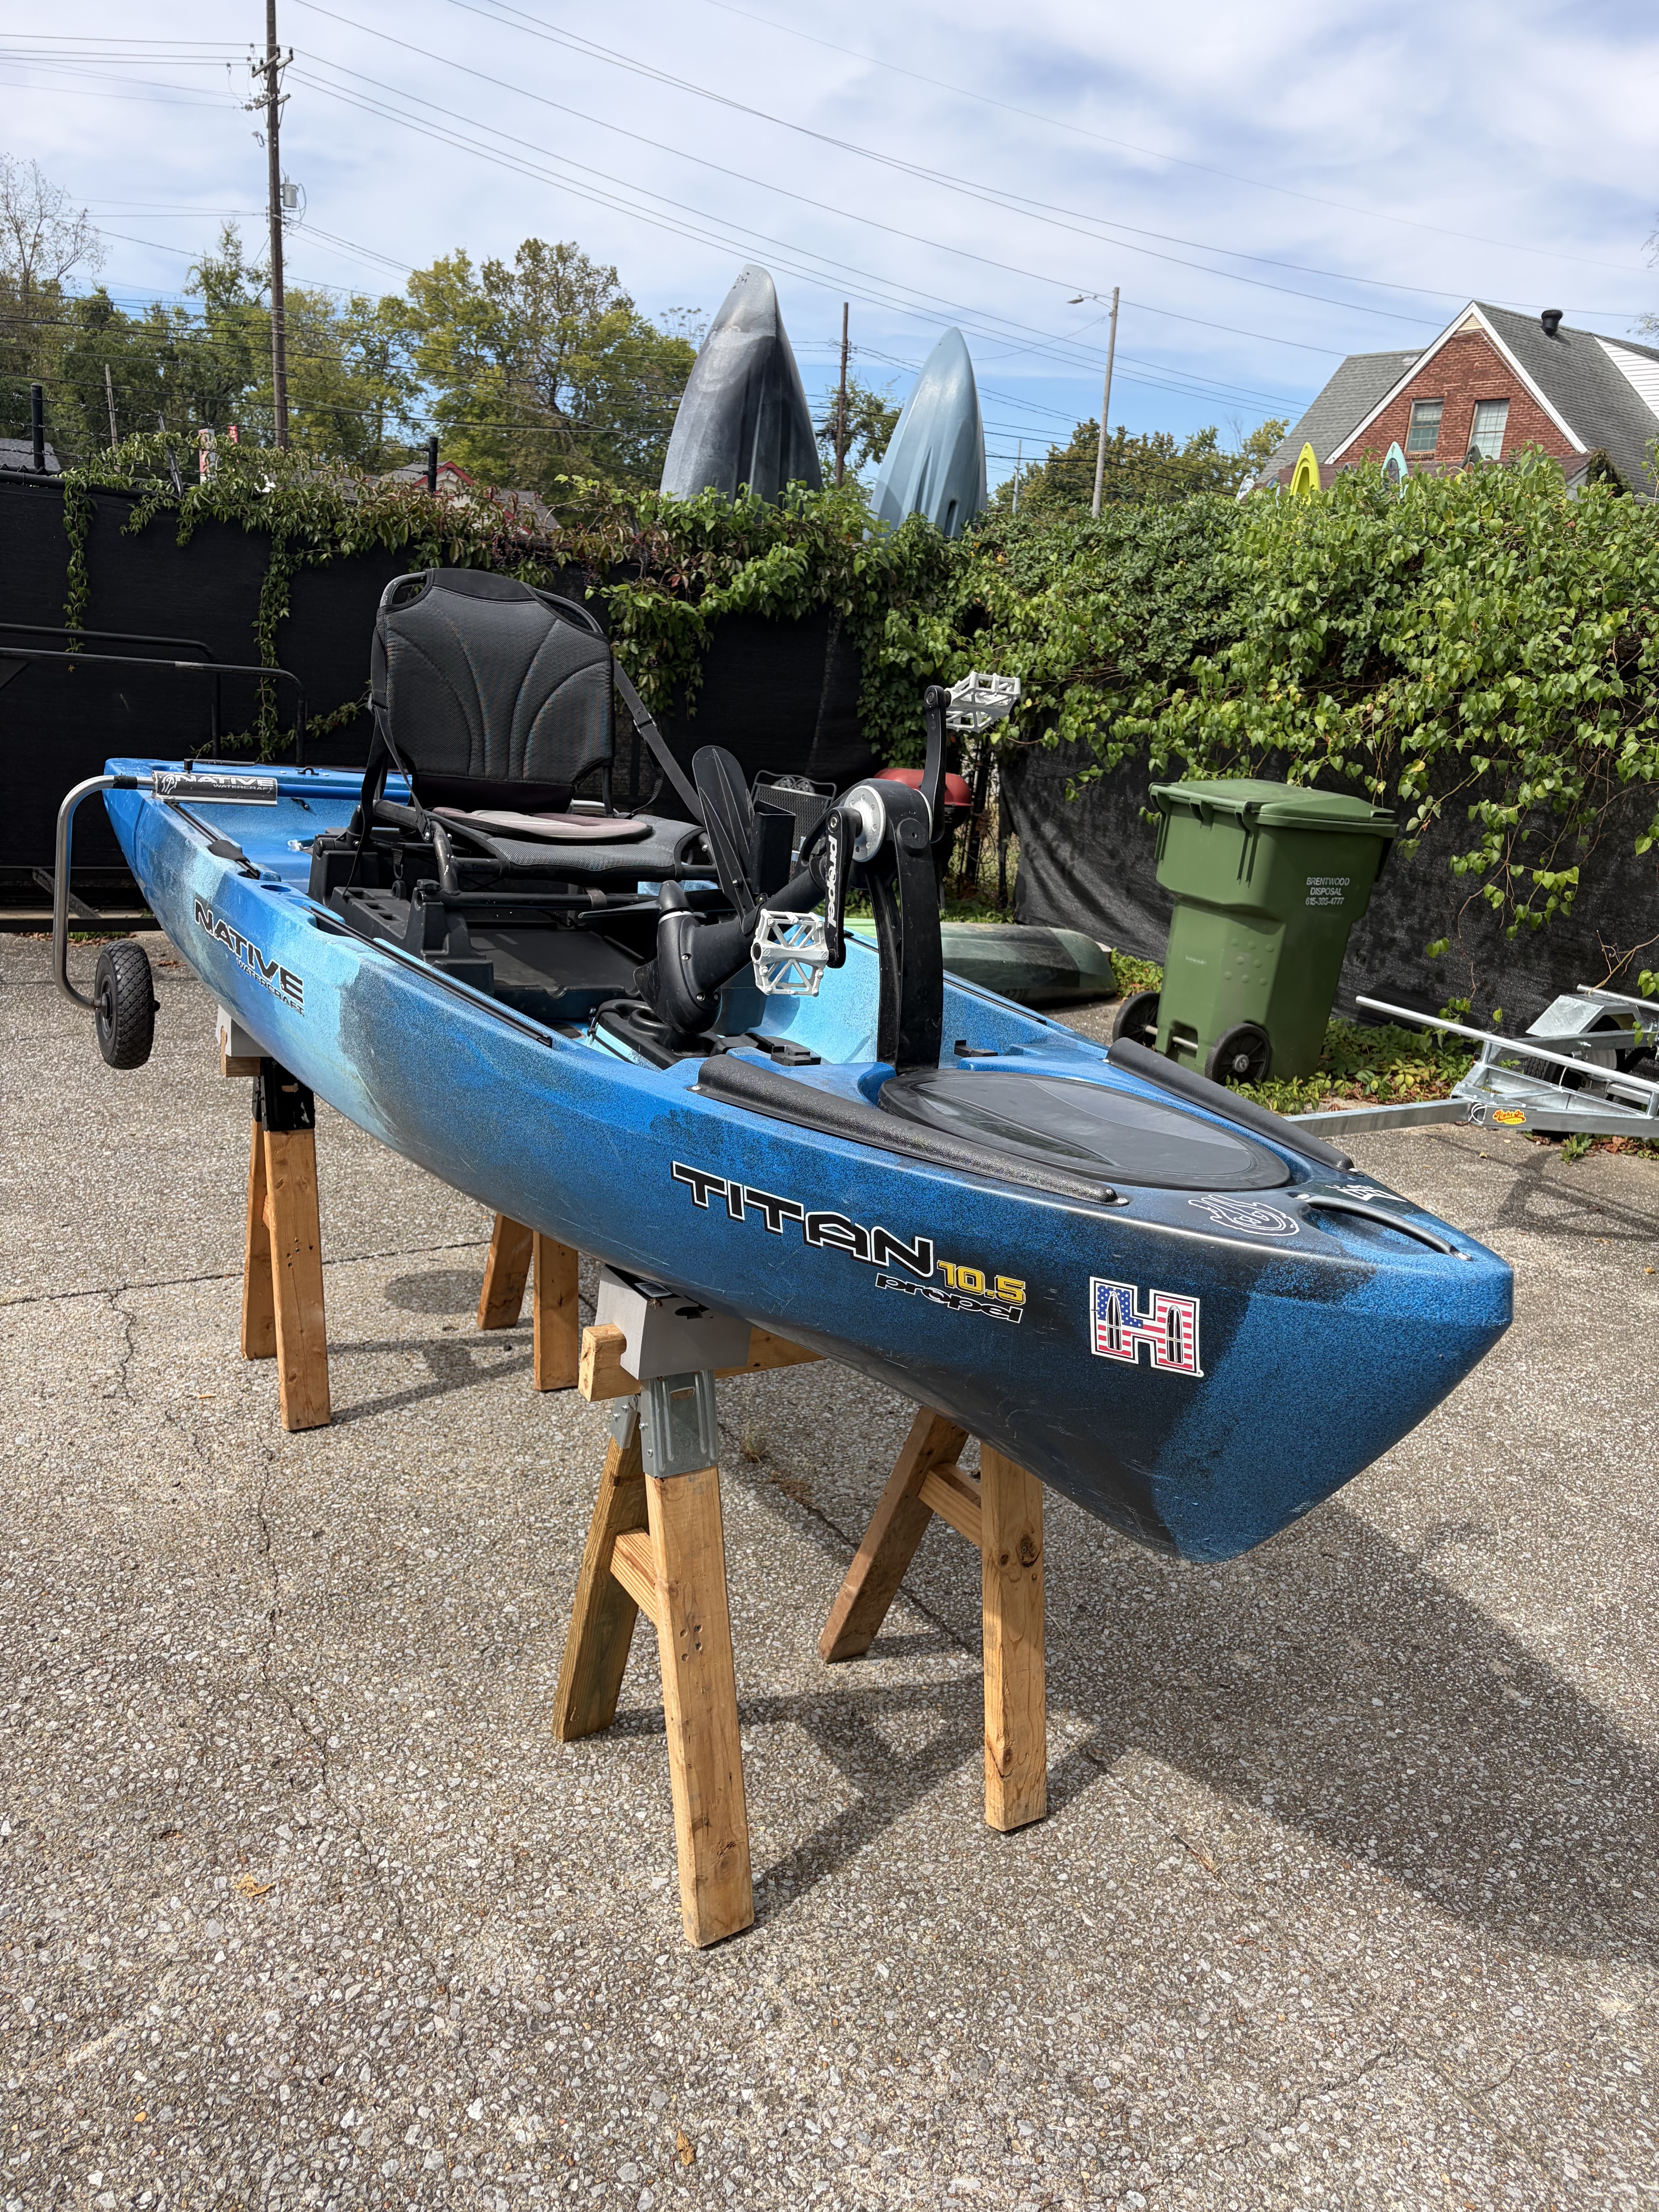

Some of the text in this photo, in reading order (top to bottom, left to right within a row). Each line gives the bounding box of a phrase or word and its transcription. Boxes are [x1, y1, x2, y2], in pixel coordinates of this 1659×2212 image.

[175, 774, 274, 787] NATIVE
[826, 835, 838, 928] propel
[1306, 877, 1350, 886] BRENTWOOD
[1310, 887, 1342, 895] DISPOSAL
[194, 898, 305, 1006] NATIVE
[236, 957, 304, 1016] WATERCRAFT
[670, 1161, 1026, 1305] TITAN 10.5
[875, 1273, 1024, 1324] propel
